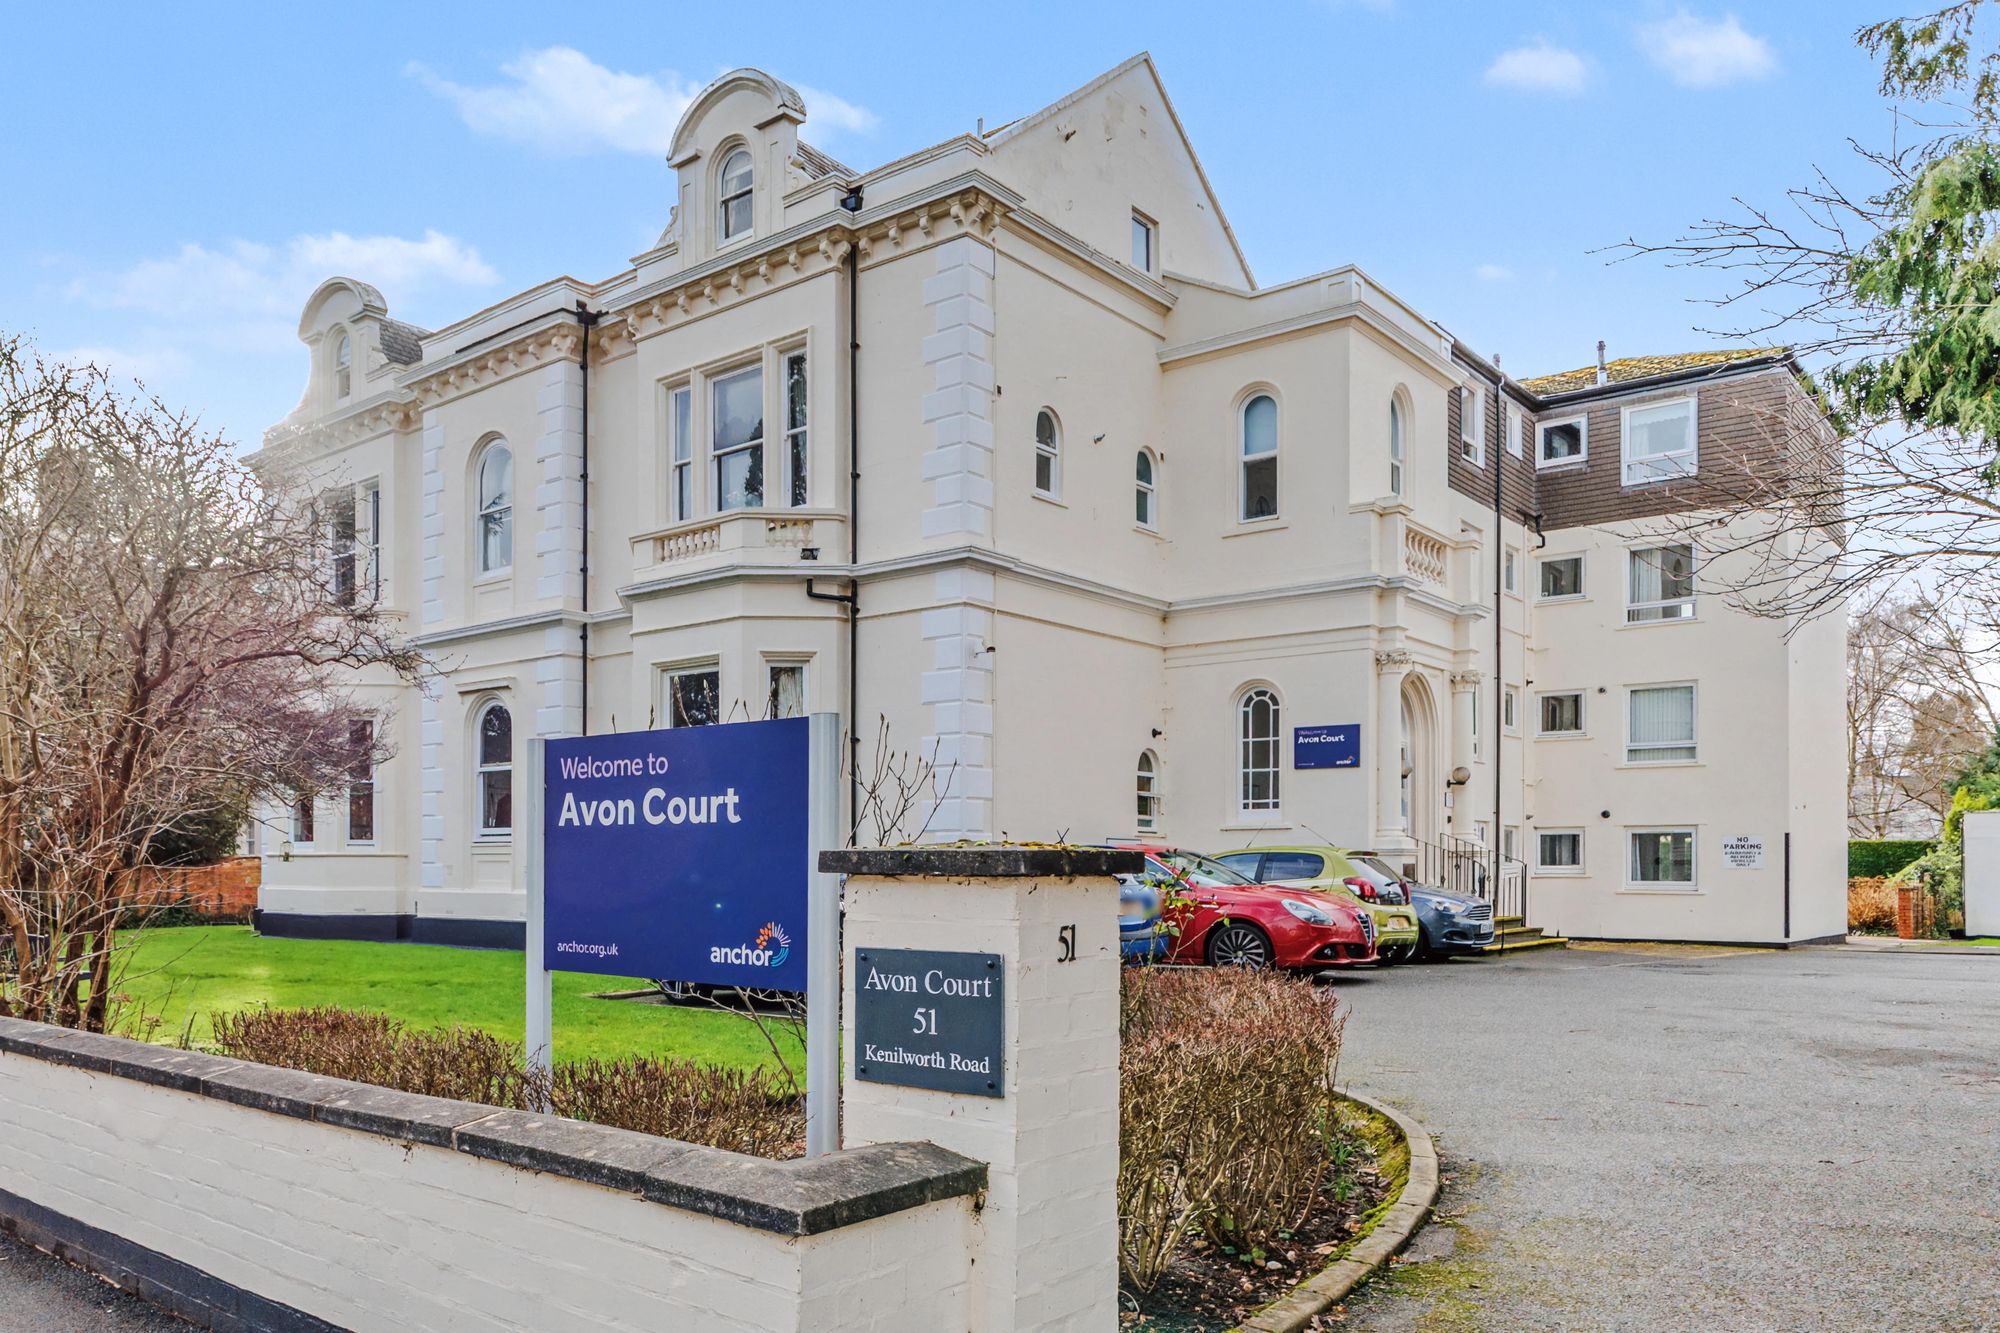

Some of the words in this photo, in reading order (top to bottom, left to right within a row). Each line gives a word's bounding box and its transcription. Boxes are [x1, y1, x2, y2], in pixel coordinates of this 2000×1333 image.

[1298, 736, 1319, 744] Avon
[1320, 734, 1345, 742] Court
[560, 756, 643, 780] Welcome
[647, 753, 669, 775] to
[558, 792, 635, 827] Avon
[642, 787, 742, 826] Court
[557, 941, 619, 958] anchor.org.uk
[710, 943, 773, 967] anchor
[1057, 924, 1076, 962] 51
[864, 966, 918, 993] Avon
[924, 970, 992, 998] Court
[912, 1007, 938, 1035] 51
[865, 1044, 946, 1069] Kenilworth
[949, 1053, 990, 1074] Road
